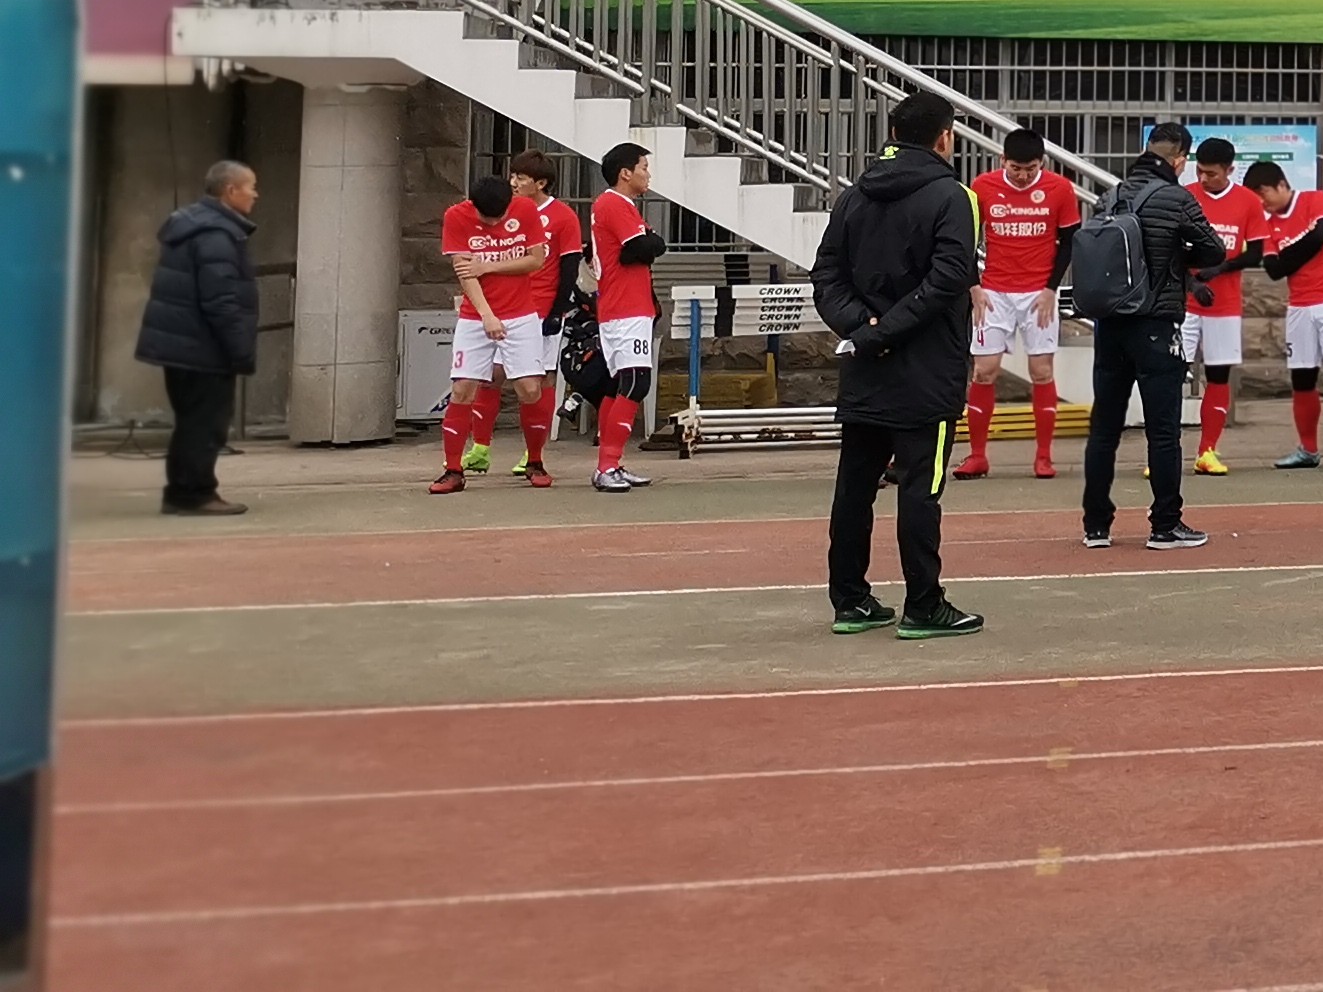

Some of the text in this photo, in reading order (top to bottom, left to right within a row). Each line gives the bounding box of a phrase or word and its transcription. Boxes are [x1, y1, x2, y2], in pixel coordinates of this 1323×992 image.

[759, 288, 801, 296] CROWN
[758, 313, 801, 321] CROWN
[758, 323, 801, 333] CROWN
[633, 338, 650, 356] 88
